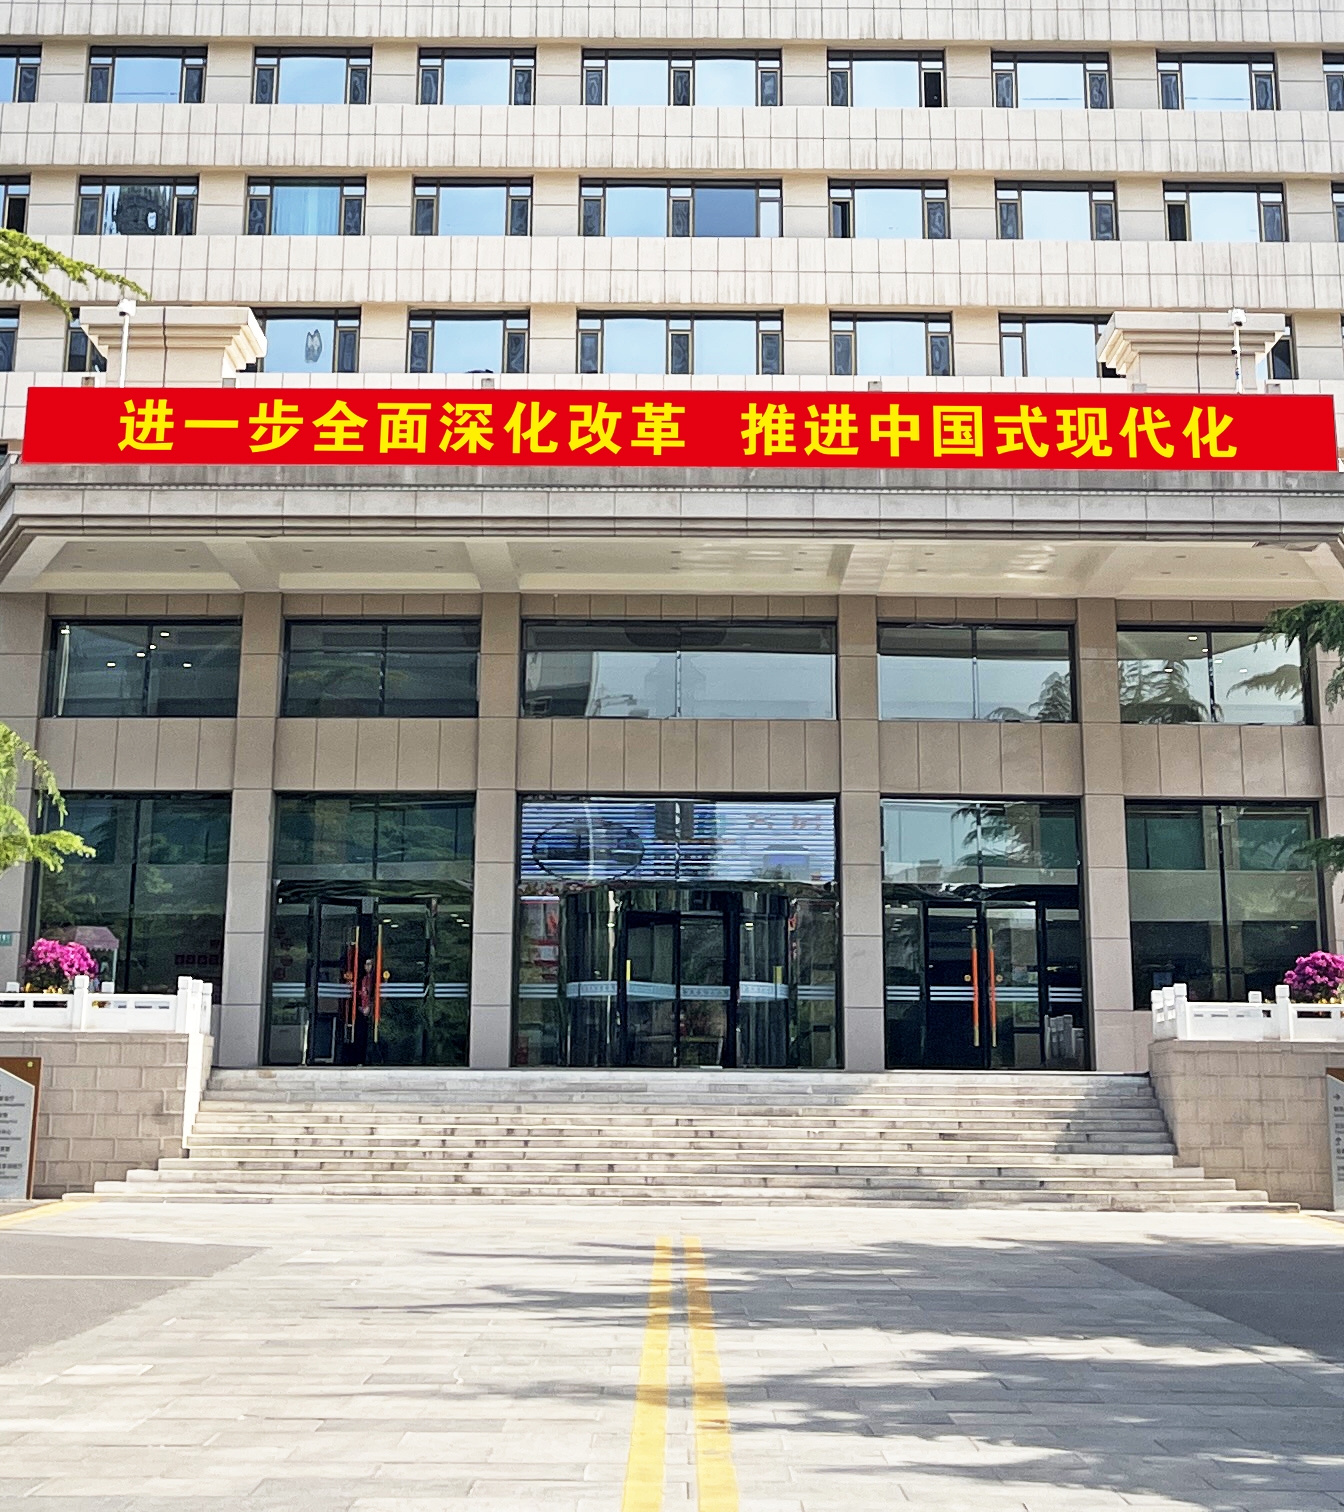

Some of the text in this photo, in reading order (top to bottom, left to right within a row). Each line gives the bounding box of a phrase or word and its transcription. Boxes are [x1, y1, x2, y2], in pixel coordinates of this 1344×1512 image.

[118, 399, 1236, 457] 进一步全面深化改革 推进中国式现代化
